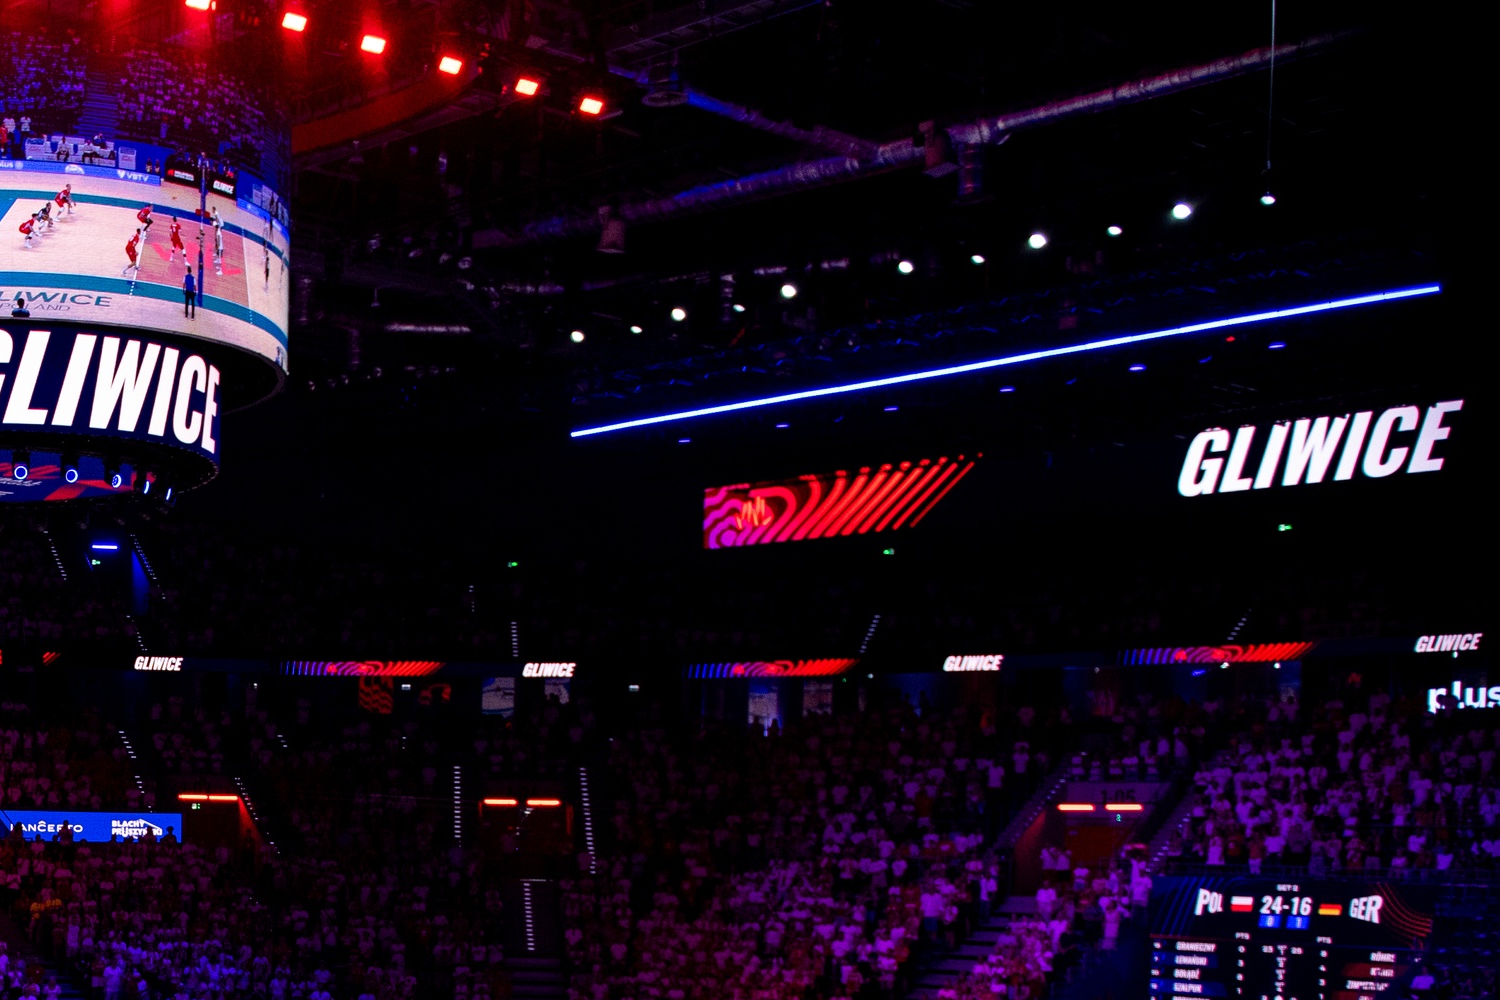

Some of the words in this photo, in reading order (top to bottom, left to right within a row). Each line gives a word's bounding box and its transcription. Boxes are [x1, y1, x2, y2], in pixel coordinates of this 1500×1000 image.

[1177, 400, 1464, 497] GLIWICE
[1414, 633, 1483, 653] GLIWICE
[134, 656, 184, 671] GLIWICE
[522, 662, 577, 678] GLIWICE
[943, 654, 1004, 672] GLIWICE
[1194, 888, 1223, 916] POL
[1259, 895, 1312, 916] 24-16
[1349, 894, 1383, 924] GER
